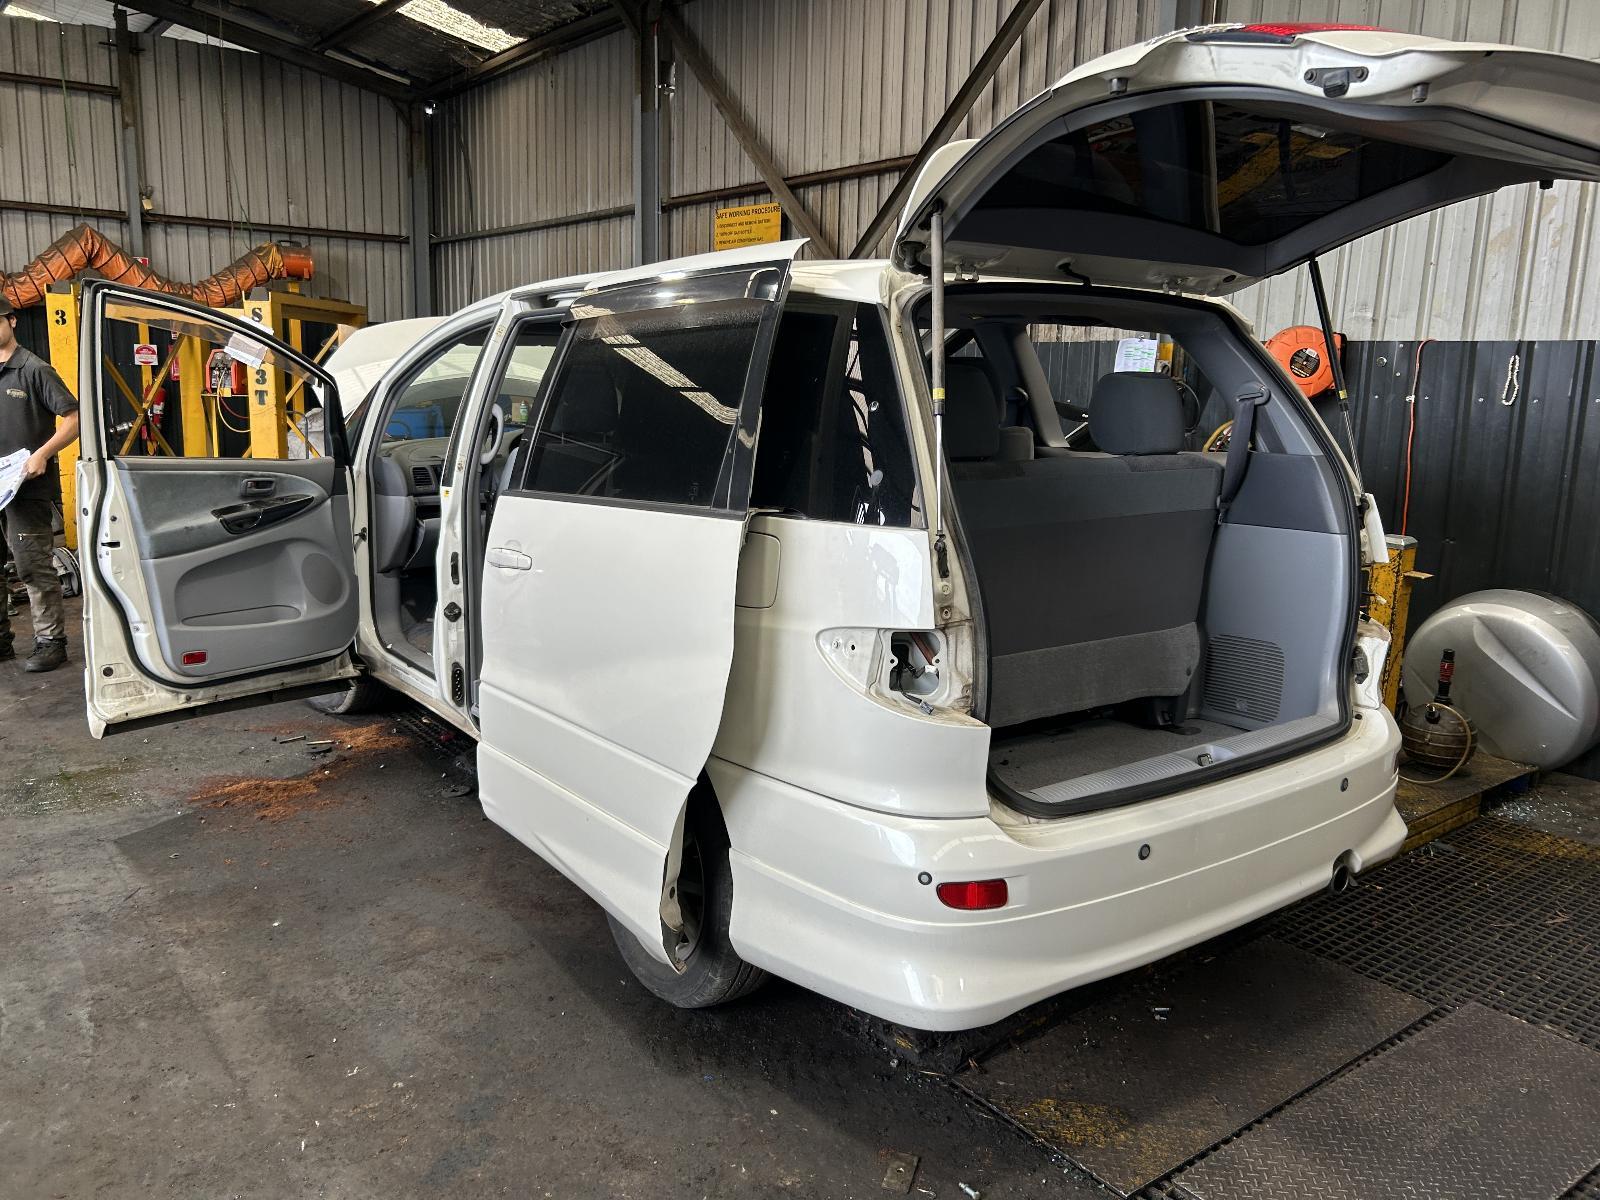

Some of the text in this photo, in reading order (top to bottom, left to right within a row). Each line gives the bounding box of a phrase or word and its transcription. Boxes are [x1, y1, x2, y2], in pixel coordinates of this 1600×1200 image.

[716, 206, 780, 220] SAFE WORKING PROCEDURE
[55, 309, 67, 326] 3
